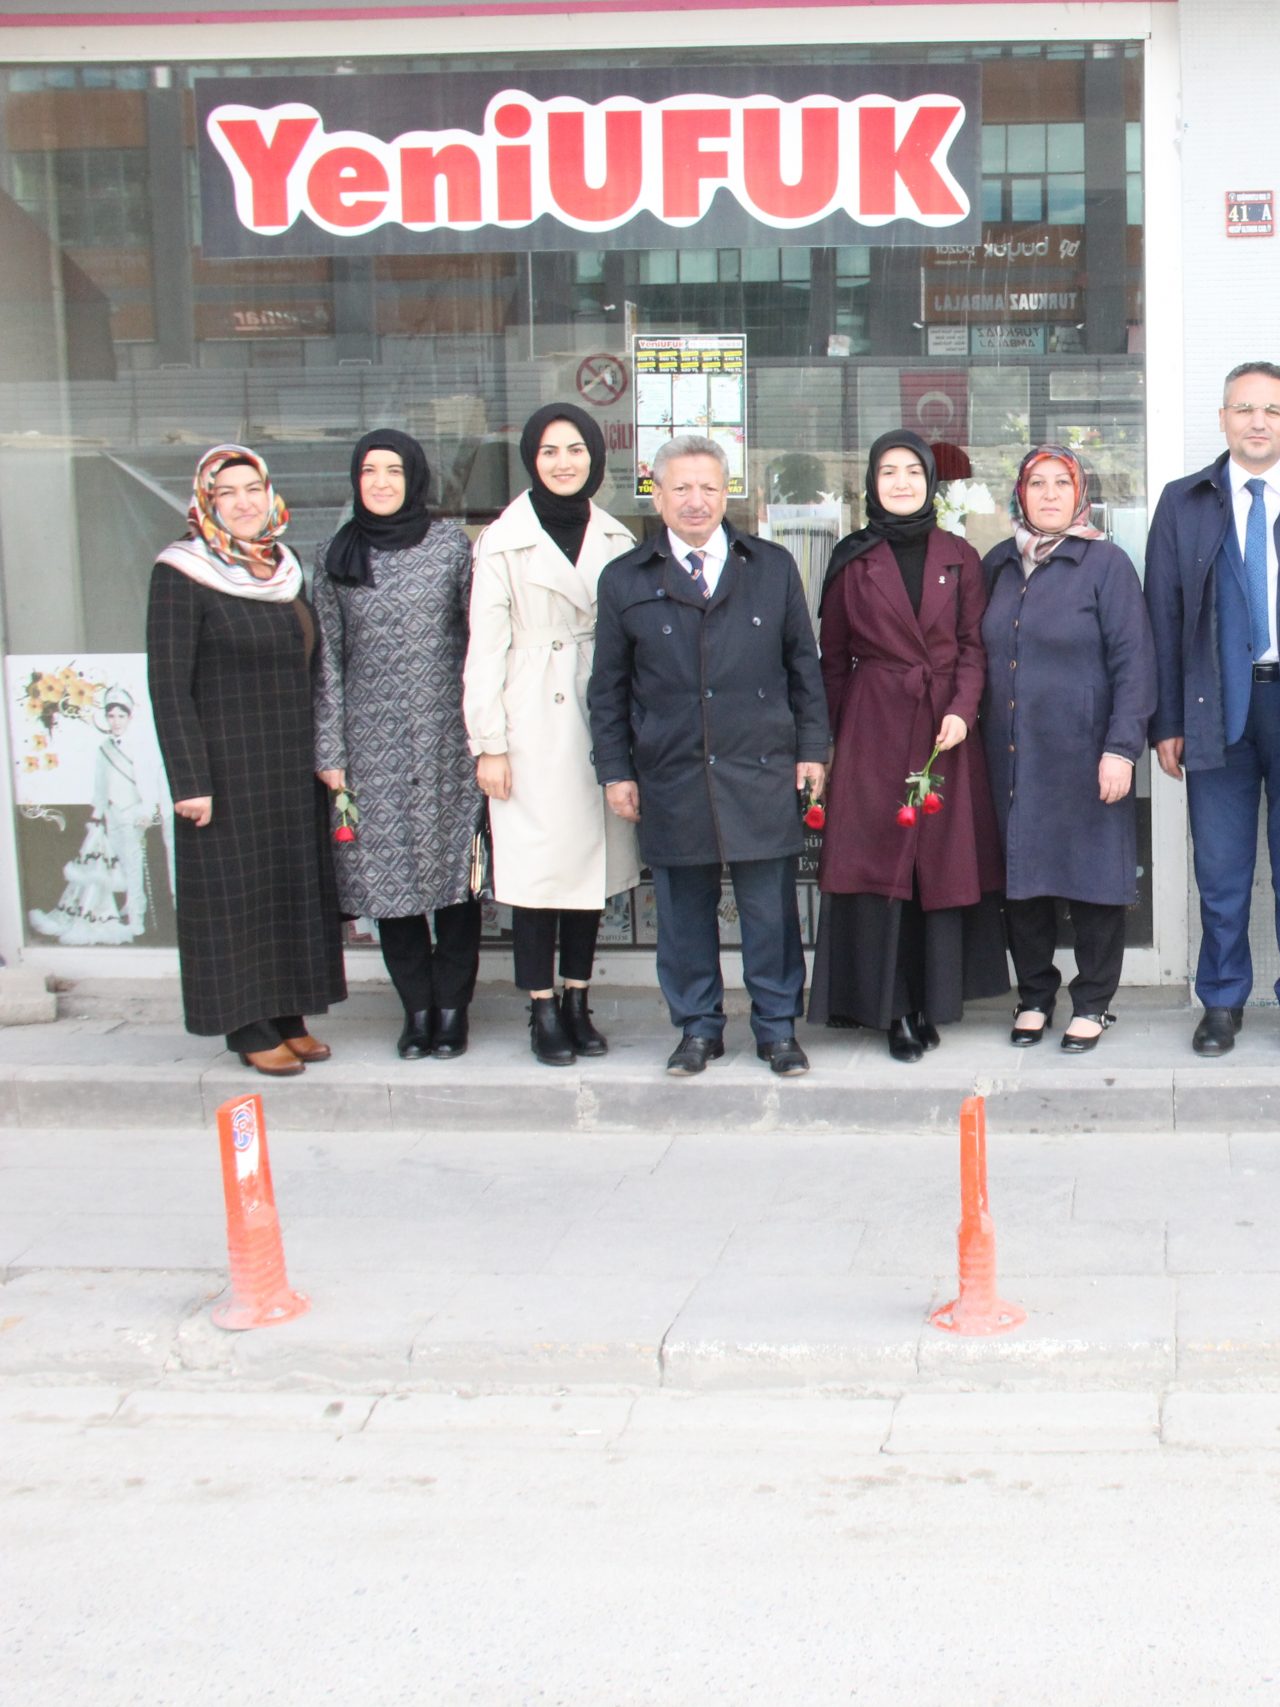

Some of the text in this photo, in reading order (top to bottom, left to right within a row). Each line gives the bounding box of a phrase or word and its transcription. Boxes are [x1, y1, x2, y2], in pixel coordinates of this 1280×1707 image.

[215, 101, 967, 228] YeniUFUK
[1229, 203, 1272, 222] 41 A
